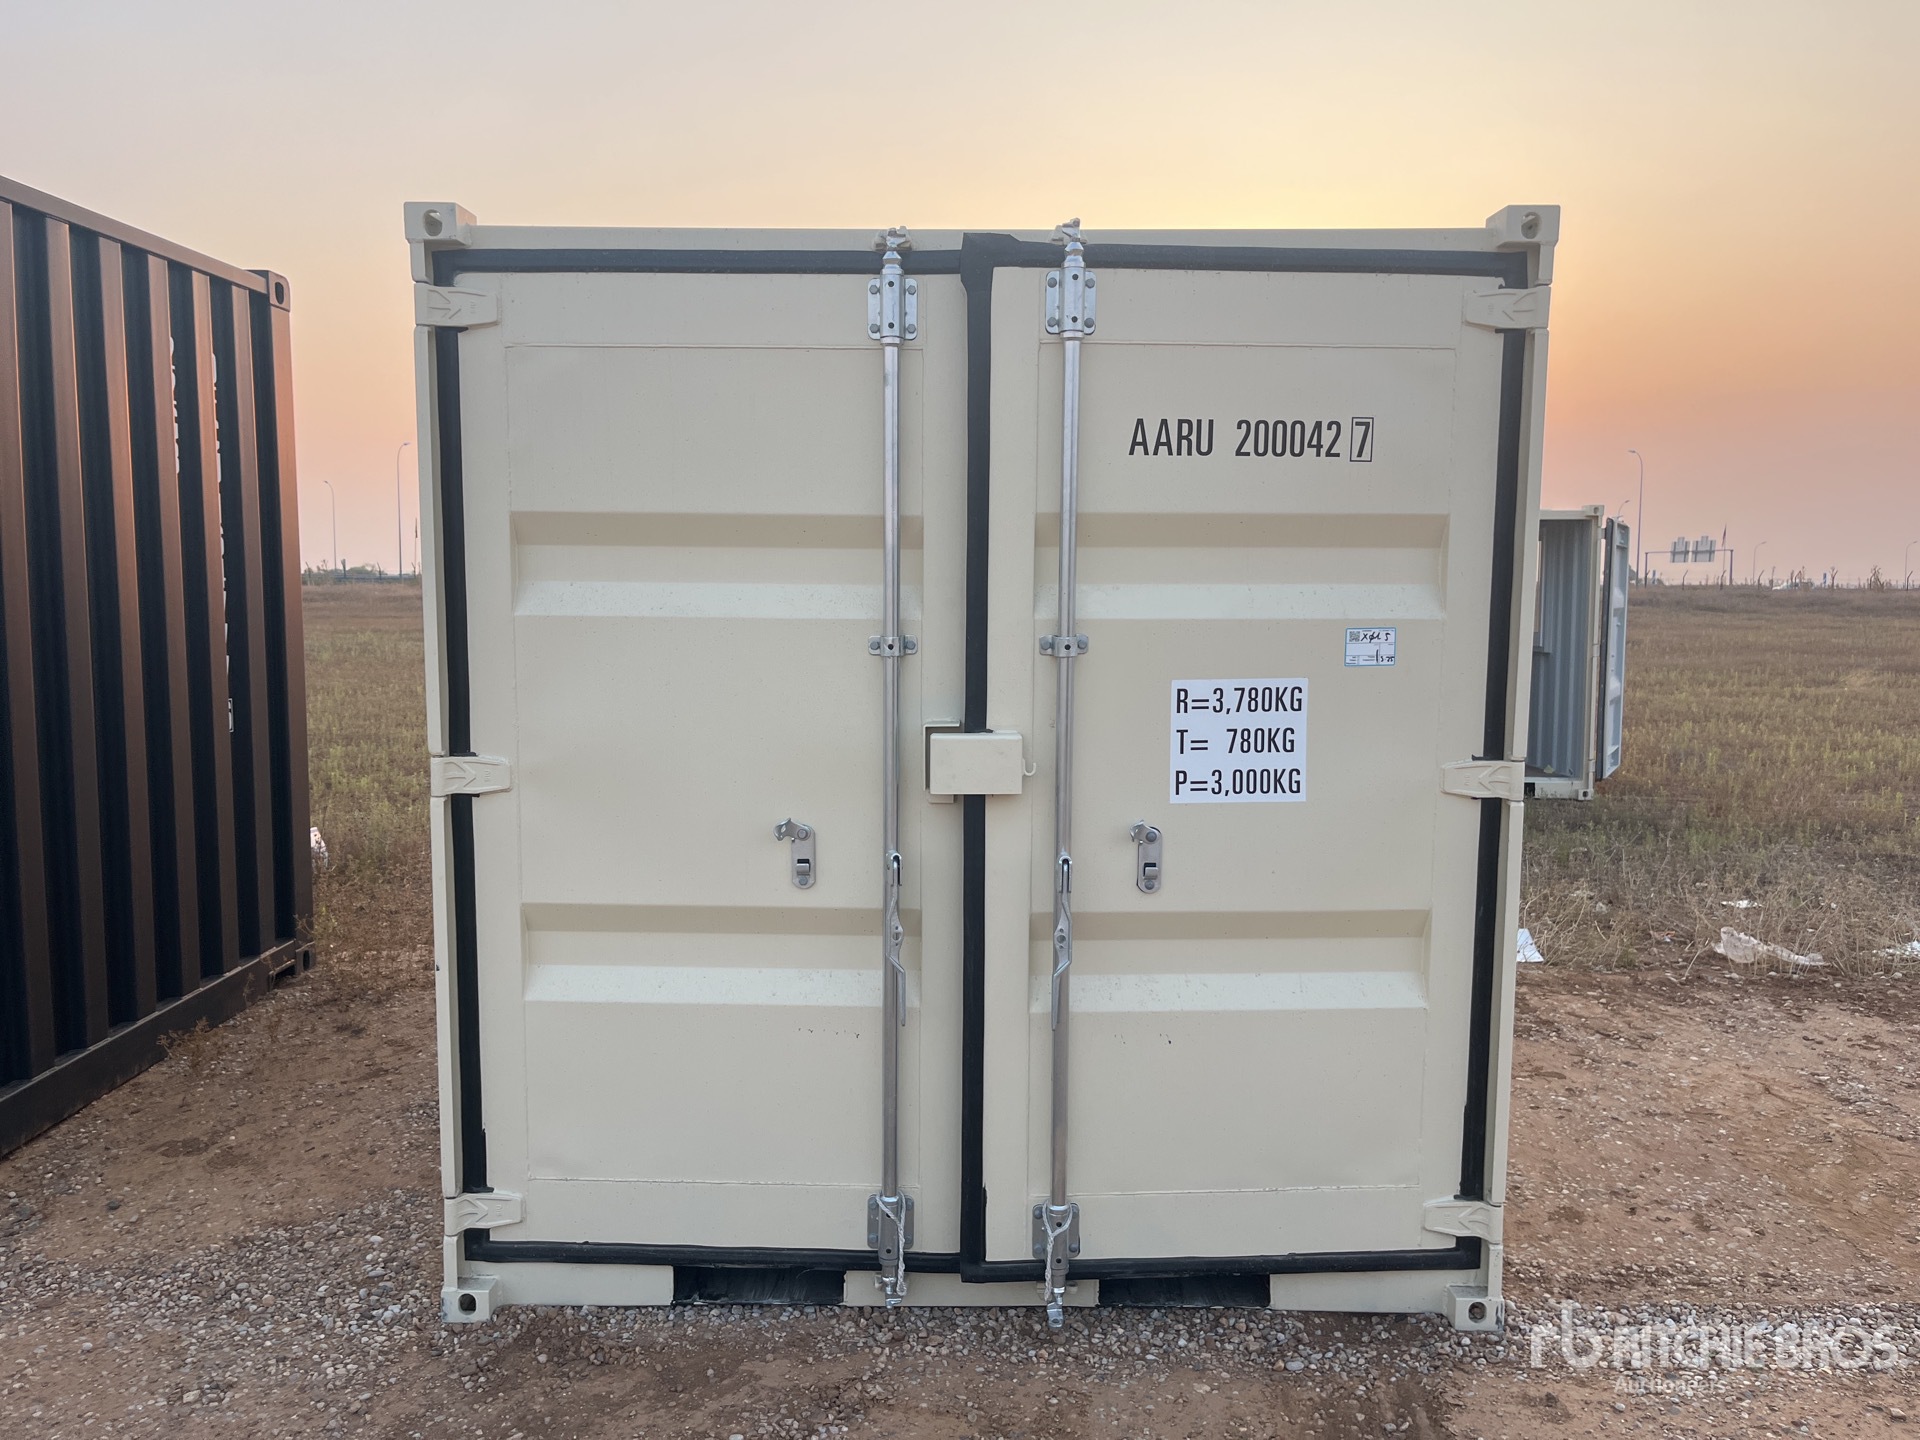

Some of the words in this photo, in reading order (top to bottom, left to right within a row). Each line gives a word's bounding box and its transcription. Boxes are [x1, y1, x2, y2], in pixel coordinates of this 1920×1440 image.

[1128, 418, 1214, 457] AARU
[1235, 419, 1342, 458] 200042
[1353, 420, 1371, 459] 7
[1176, 686, 1303, 715] R=3,780KG
[1176, 729, 1209, 755] T=
[1226, 727, 1295, 754] 780KG
[1175, 768, 1301, 797] P=3,000KG
